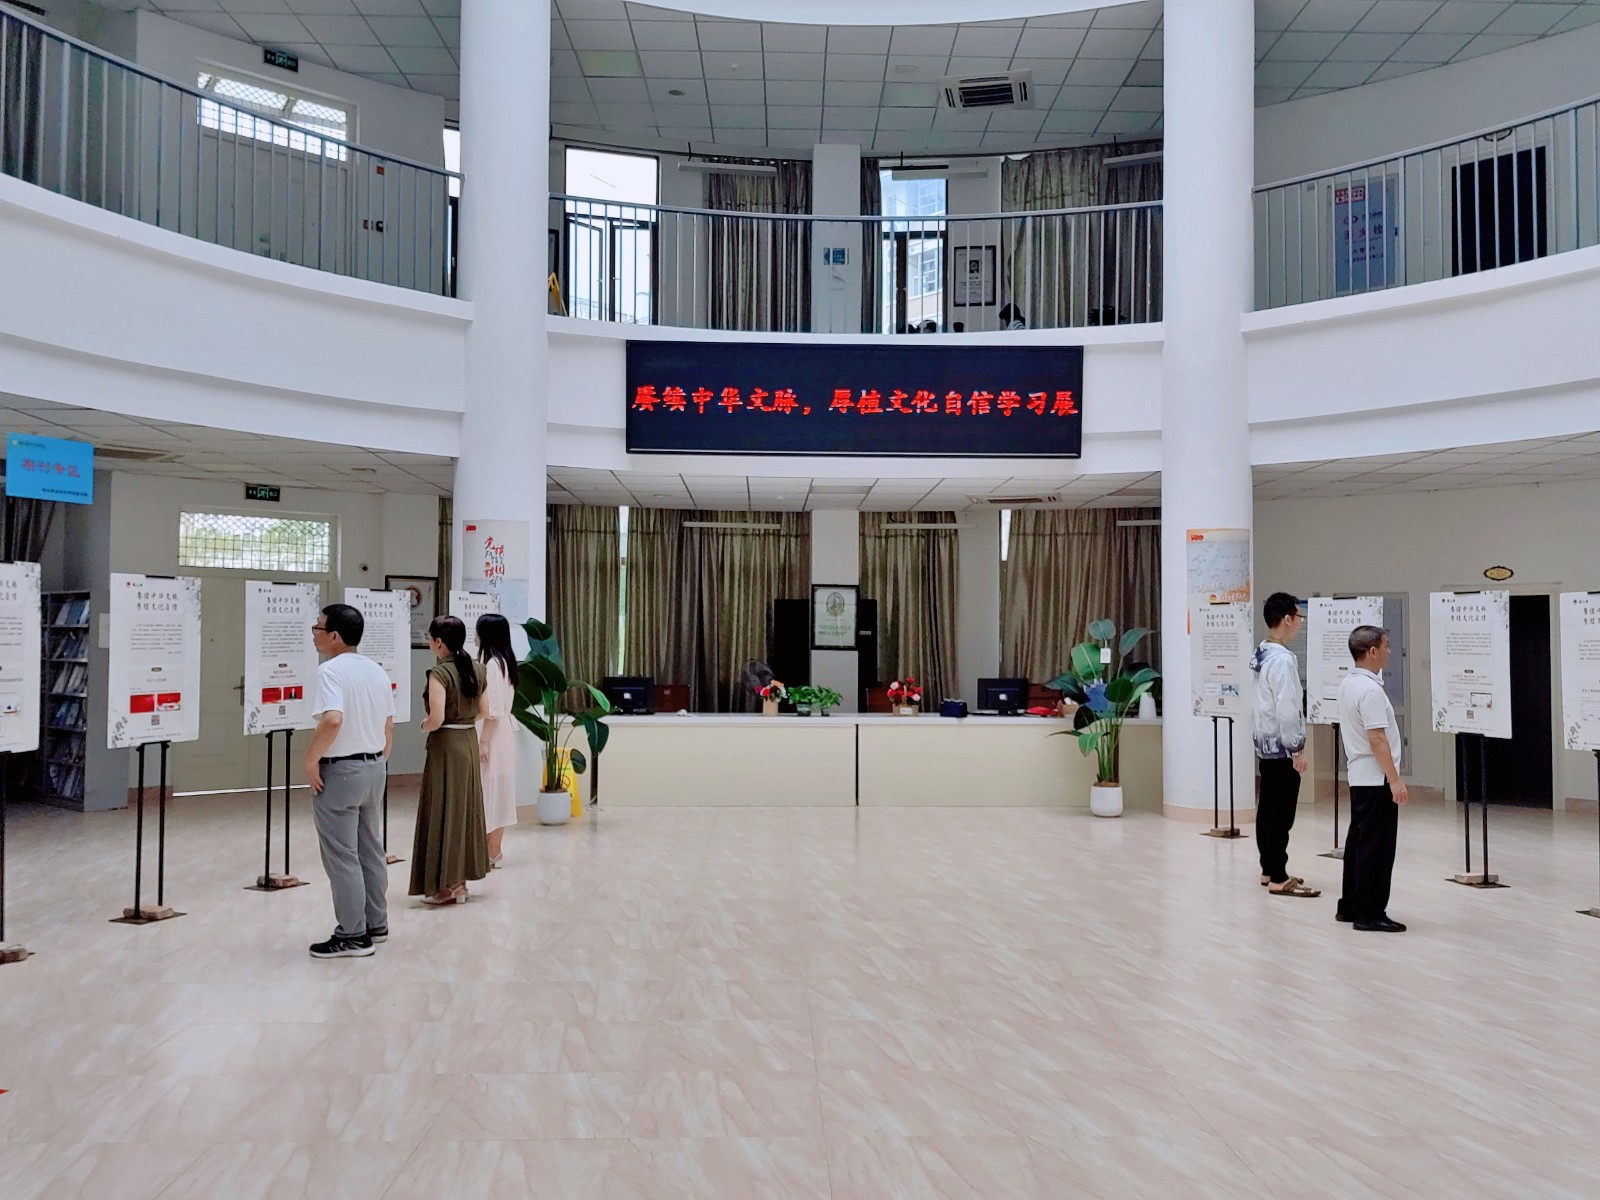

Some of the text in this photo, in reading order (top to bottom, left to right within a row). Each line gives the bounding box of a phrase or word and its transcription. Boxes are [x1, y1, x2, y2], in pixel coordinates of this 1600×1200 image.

[632, 384, 1079, 416] 赓续中华文脉，厚植文化自信学习展
